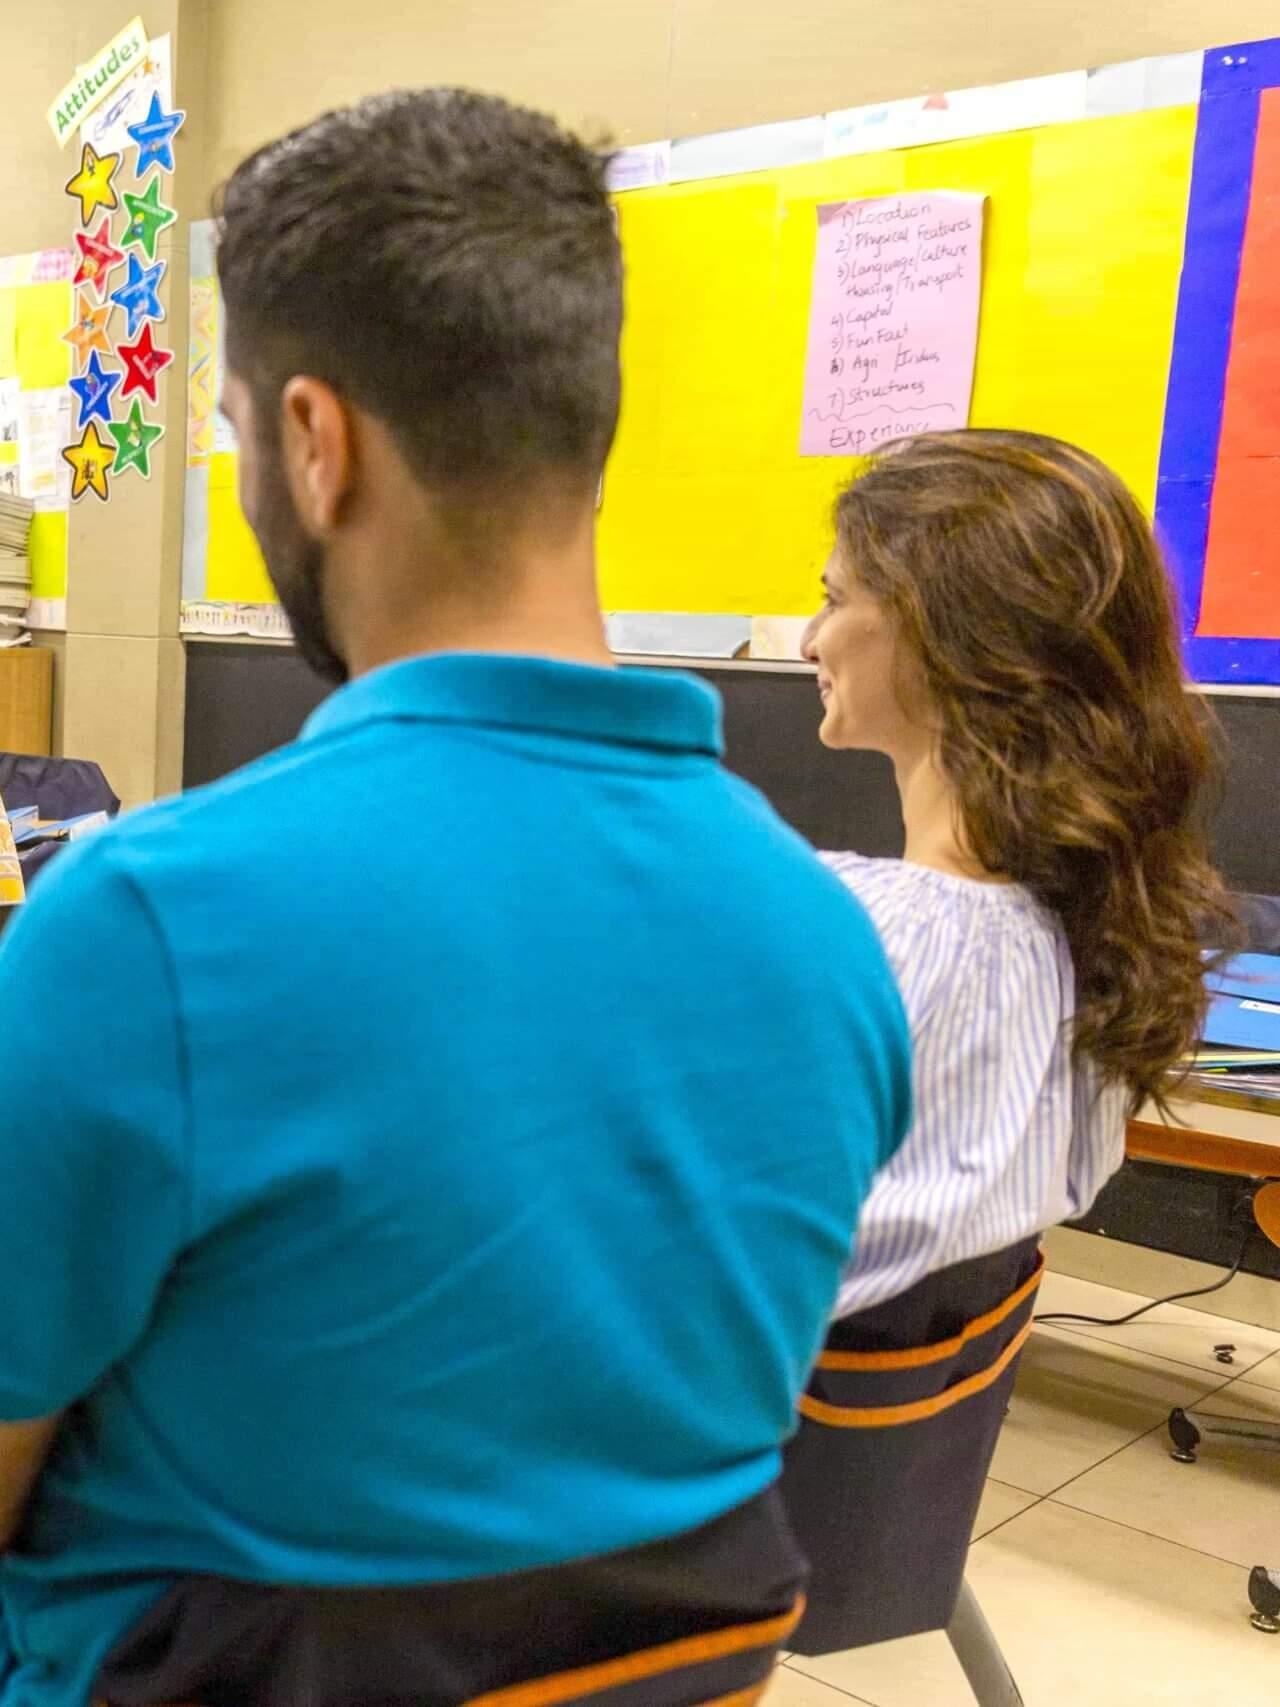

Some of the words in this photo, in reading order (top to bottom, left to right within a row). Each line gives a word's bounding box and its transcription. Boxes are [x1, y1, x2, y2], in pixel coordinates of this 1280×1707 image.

[55, 35, 141, 135] Attitudes
[855, 226, 910, 258] Physical
[848, 380, 925, 406] Structures
